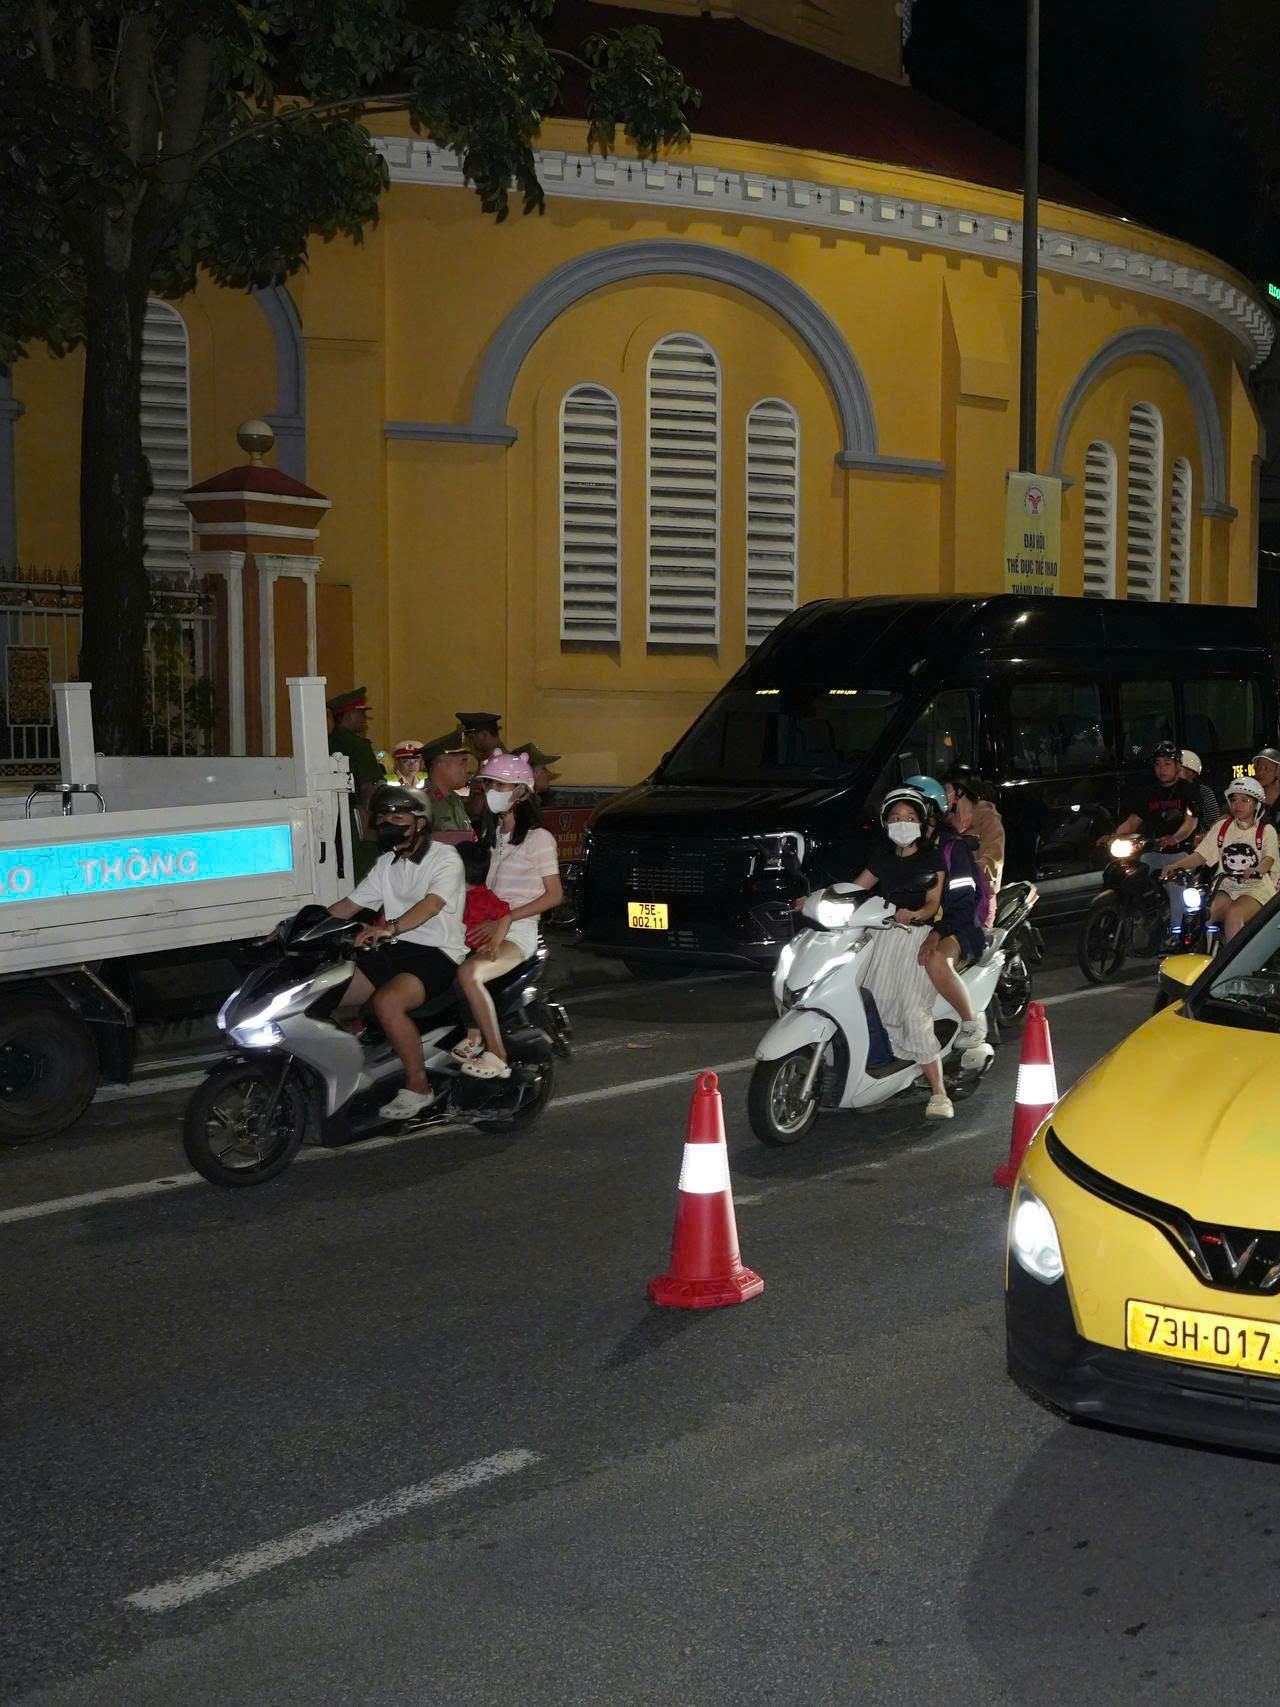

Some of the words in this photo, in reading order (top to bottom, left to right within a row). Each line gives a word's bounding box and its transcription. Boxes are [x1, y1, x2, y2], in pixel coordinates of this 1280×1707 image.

[1020, 559, 1033, 578] DỤC
[78, 848, 200, 887] THÔNG
[632, 916, 664, 929] 002.11
